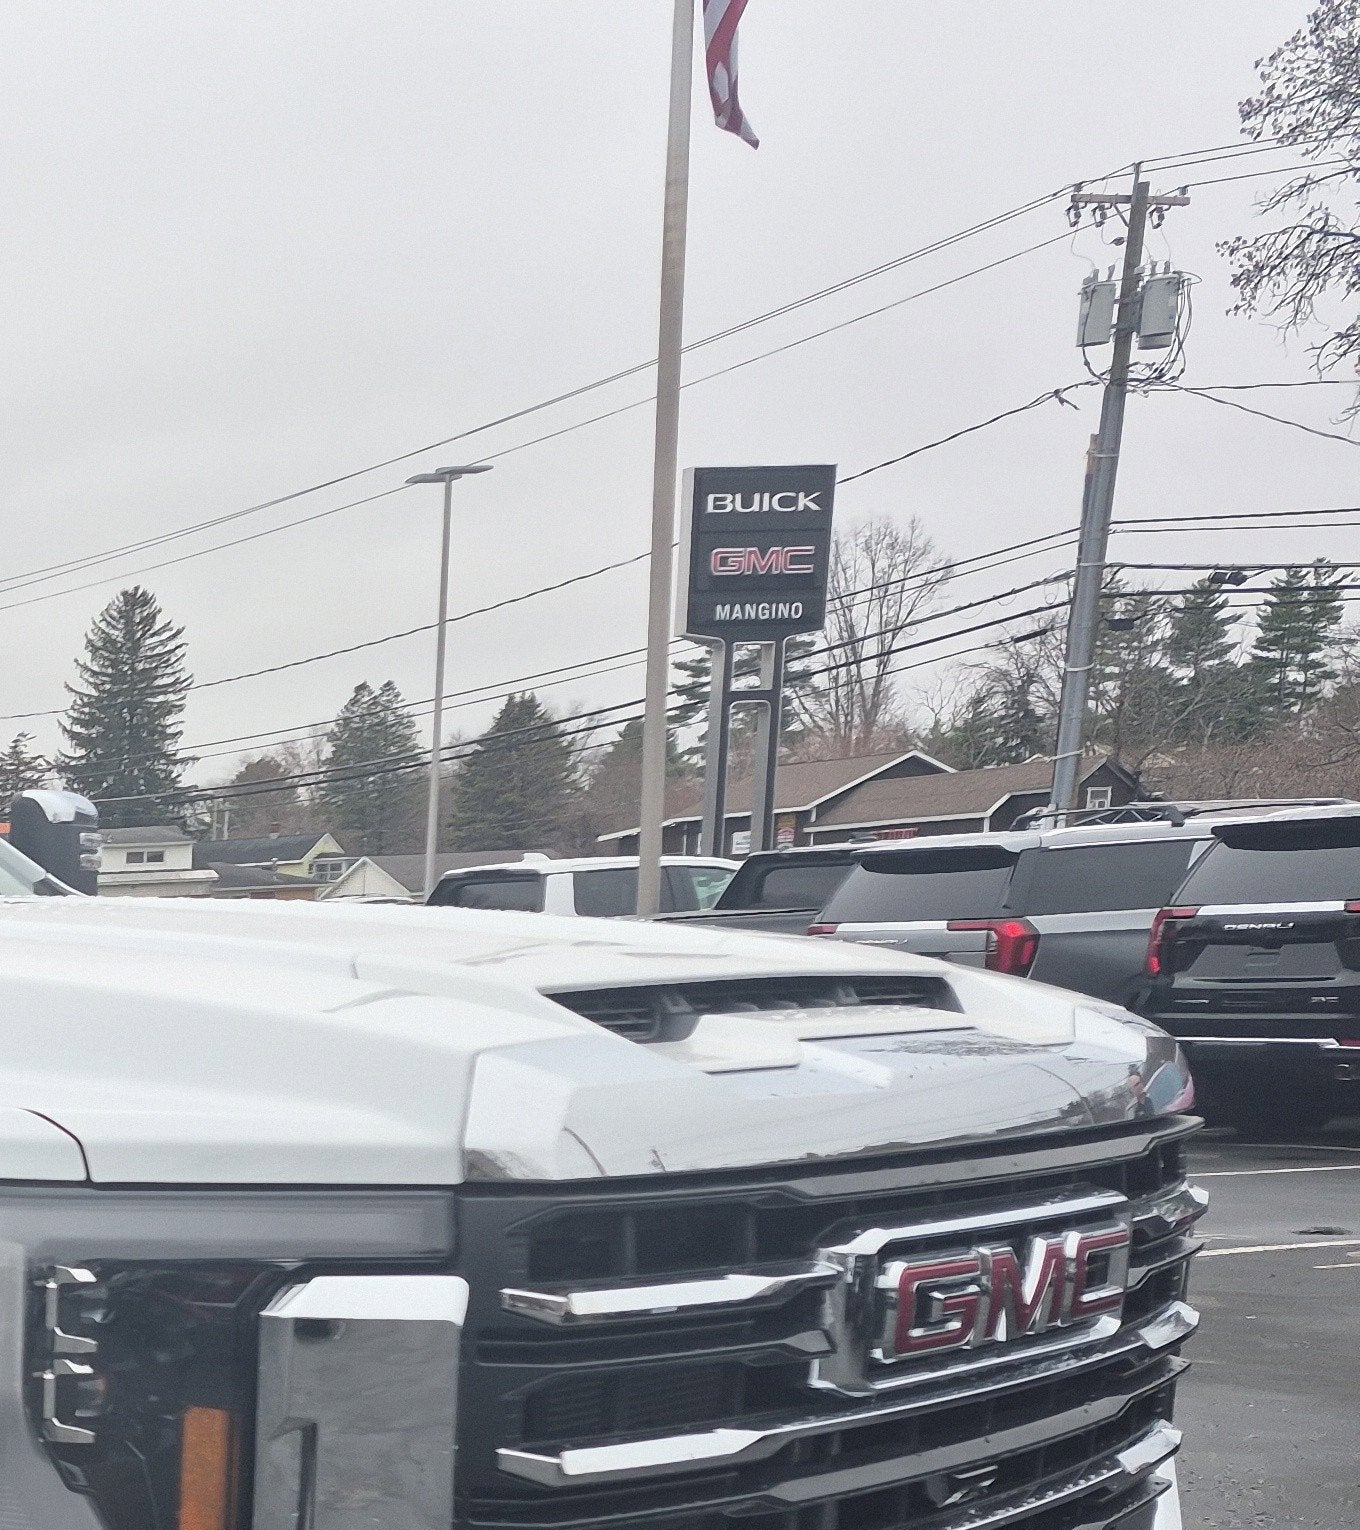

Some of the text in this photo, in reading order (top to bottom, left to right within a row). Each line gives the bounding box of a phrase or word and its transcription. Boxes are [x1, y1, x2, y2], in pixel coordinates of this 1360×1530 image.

[706, 491, 823, 514] BUICK
[711, 546, 815, 576] GMC
[714, 601, 803, 621] MANGINO
[1223, 922, 1295, 931] DENALI
[872, 1221, 1131, 1364] GMC
